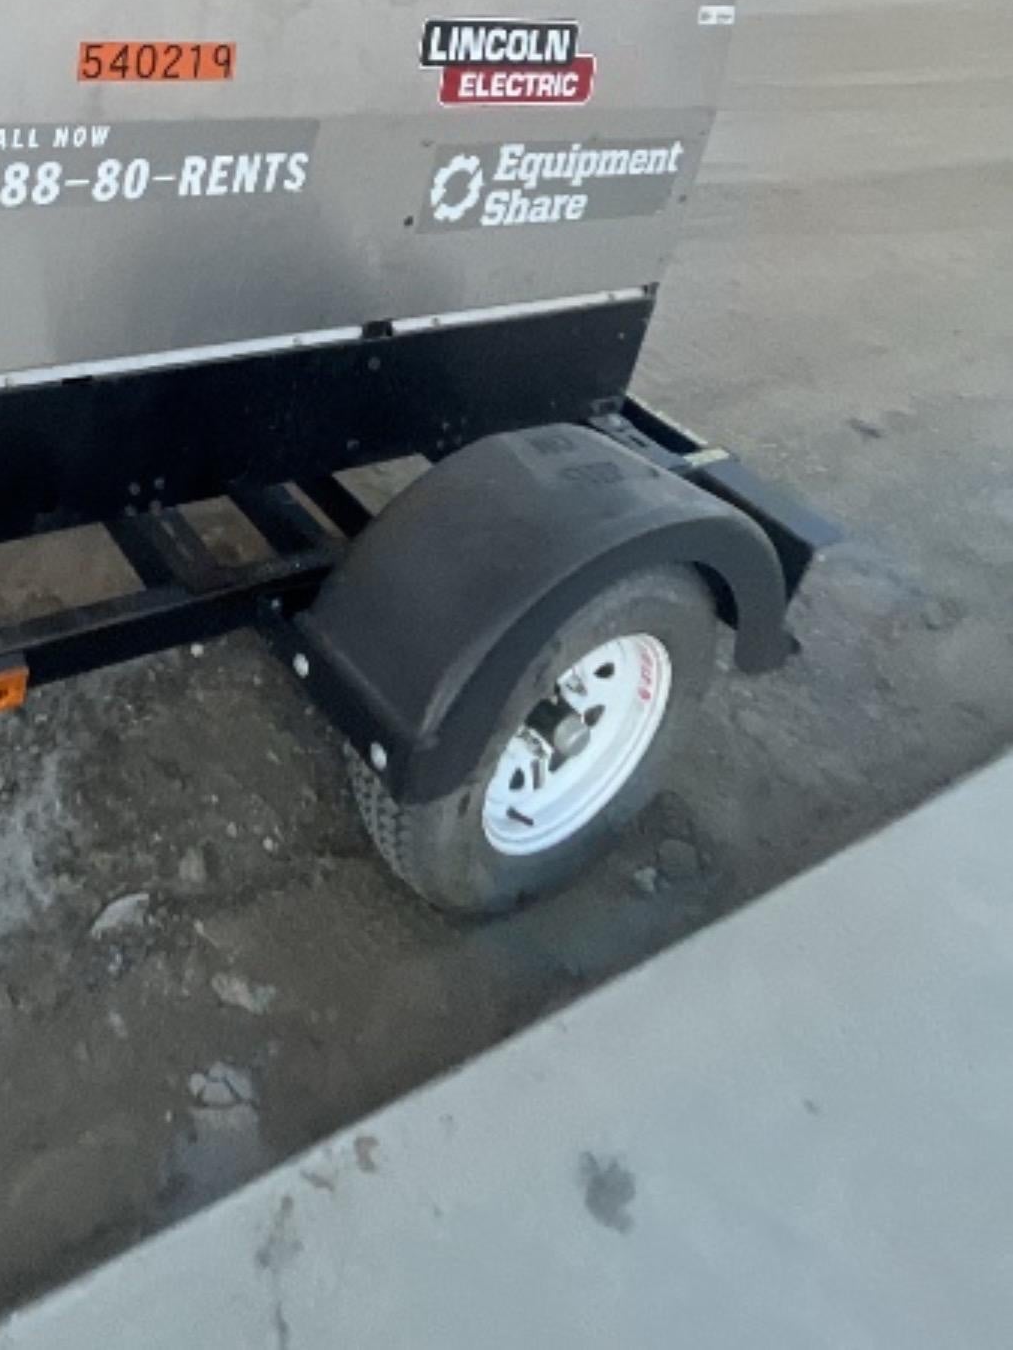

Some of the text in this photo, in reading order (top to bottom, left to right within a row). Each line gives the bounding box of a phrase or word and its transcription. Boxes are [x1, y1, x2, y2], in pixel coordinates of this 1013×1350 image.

[428, 25, 570, 62] LINCOLN
[81, 44, 233, 80] 540219
[458, 71, 580, 98] ELECTRIC
[52, 125, 111, 148] NOW
[493, 140, 684, 188] Equipment
[480, 189, 588, 227] Share
